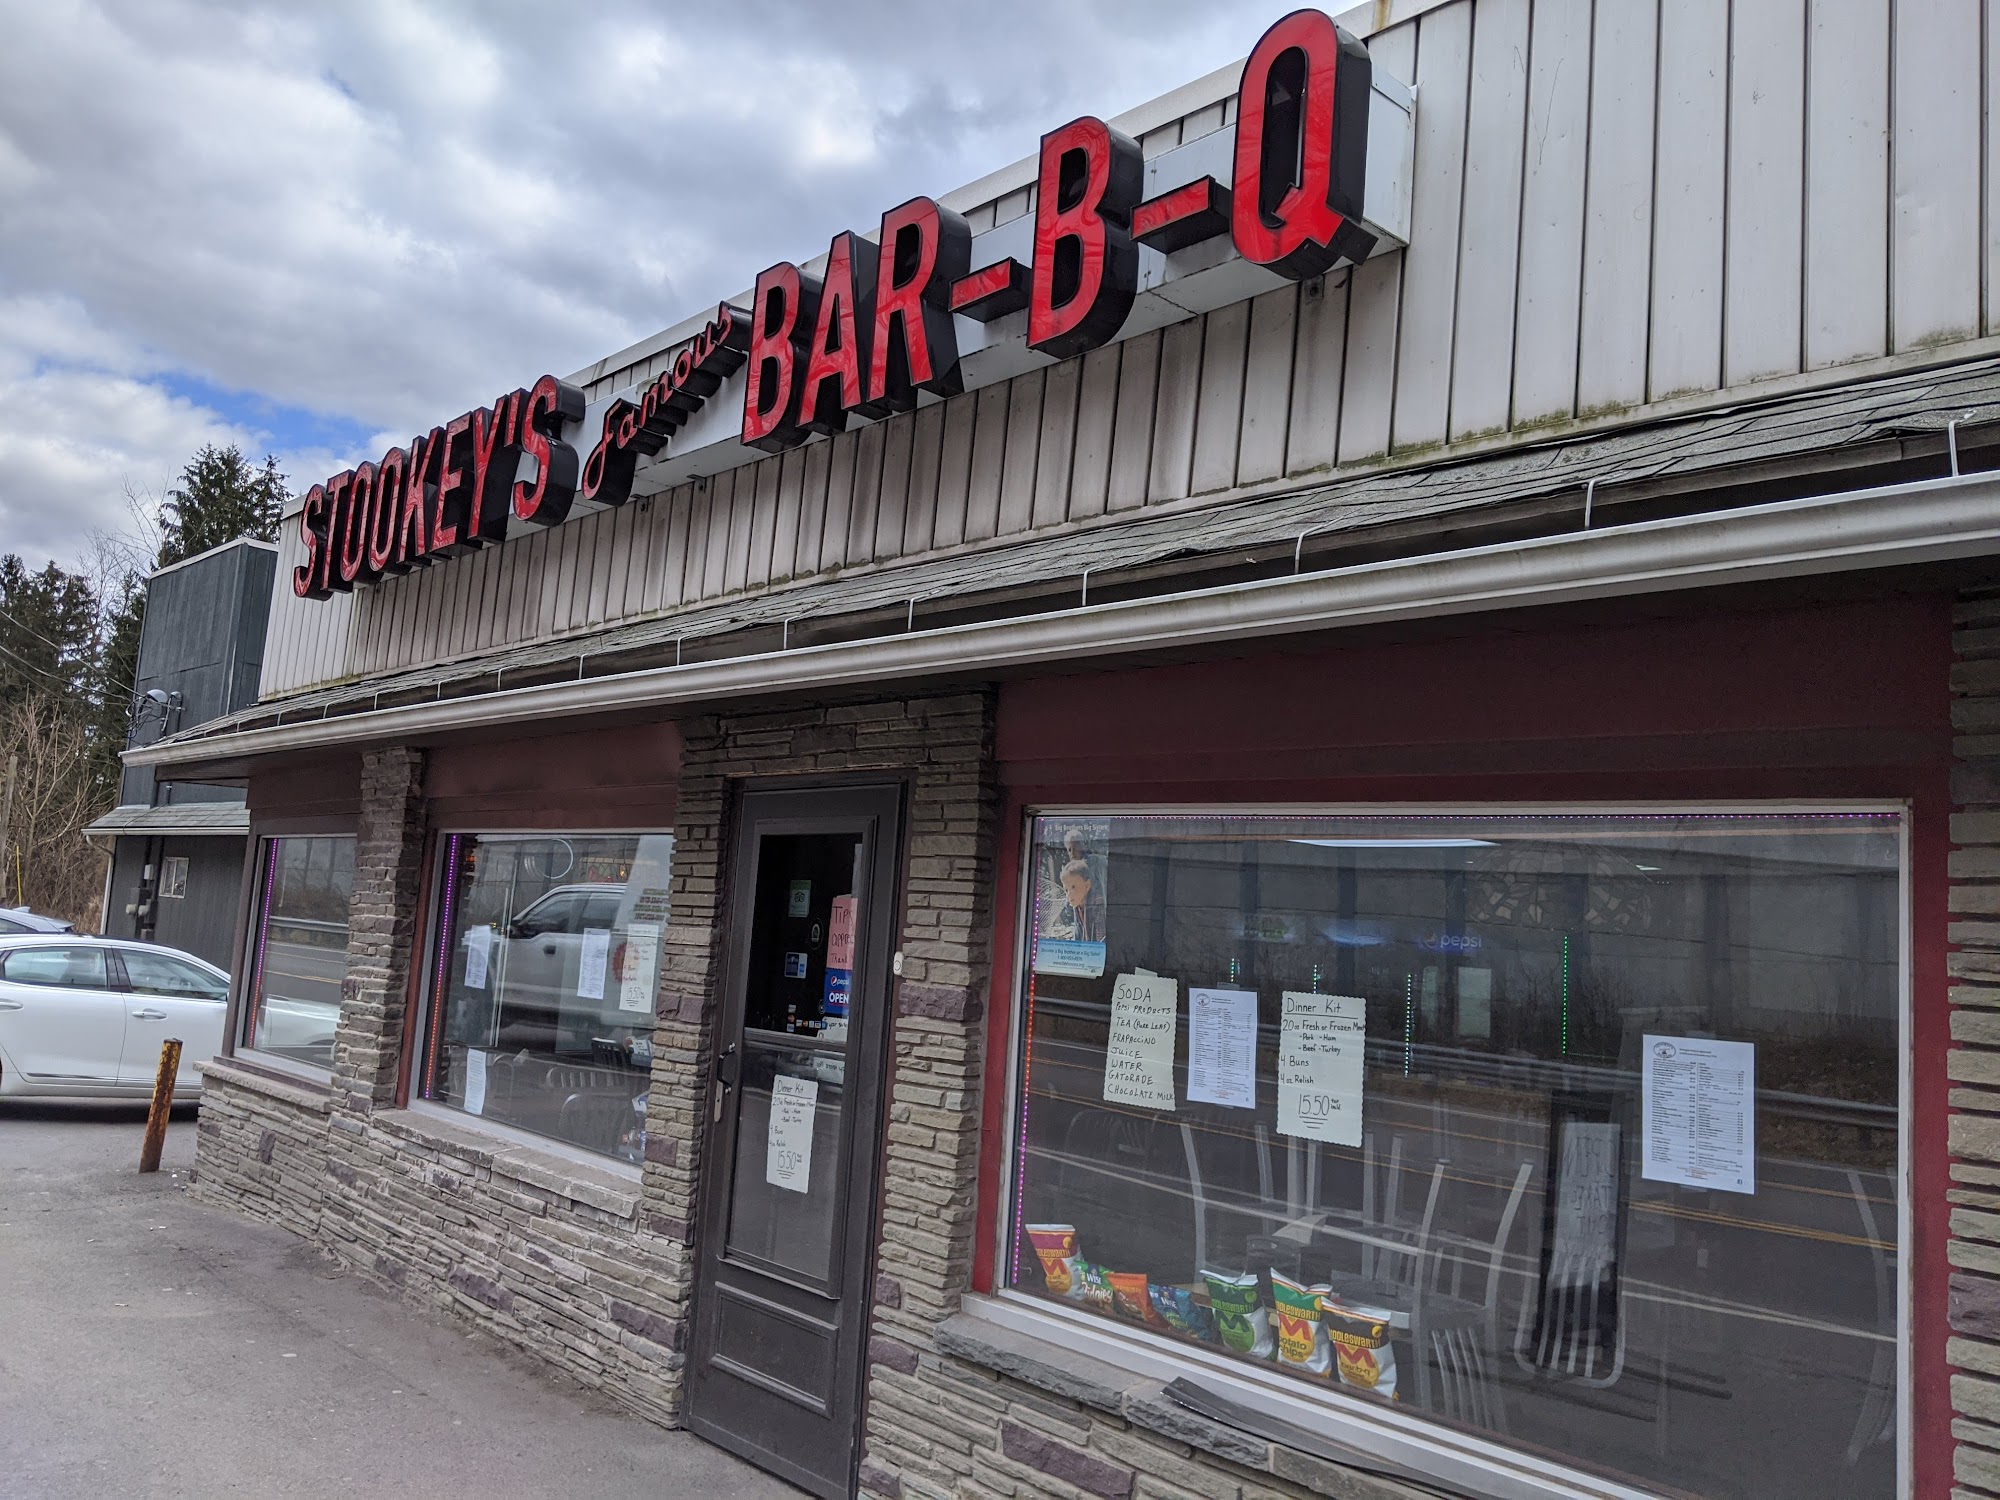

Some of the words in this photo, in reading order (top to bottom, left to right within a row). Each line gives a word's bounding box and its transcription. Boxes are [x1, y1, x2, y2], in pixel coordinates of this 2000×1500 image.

[294, 375, 584, 600] STOOKEY'S
[740, 8, 1378, 453] BAR-B-Q
[1440, 933, 1483, 949] pepsi
[829, 992, 850, 1004] OPEN
[1117, 983, 1151, 1002] SODA
[1287, 997, 1317, 1013] Dinner
[1325, 999, 1341, 1014] Kit
[1117, 1016, 1131, 1028] TEA
[1302, 1019, 1320, 1031] Fresh
[1329, 1020, 1352, 1032] Frozen
[1111, 1058, 1144, 1072] WATER
[1281, 1055, 1286, 1067] 4
[1289, 1055, 1310, 1067] Buns
[1108, 1069, 1154, 1085] GATORADE
[1294, 1074, 1314, 1084] Relish
[795, 1082, 804, 1093] Kit
[1107, 1083, 1154, 1099] CHOCOLATE
[1298, 1094, 1330, 1116] 15.50
